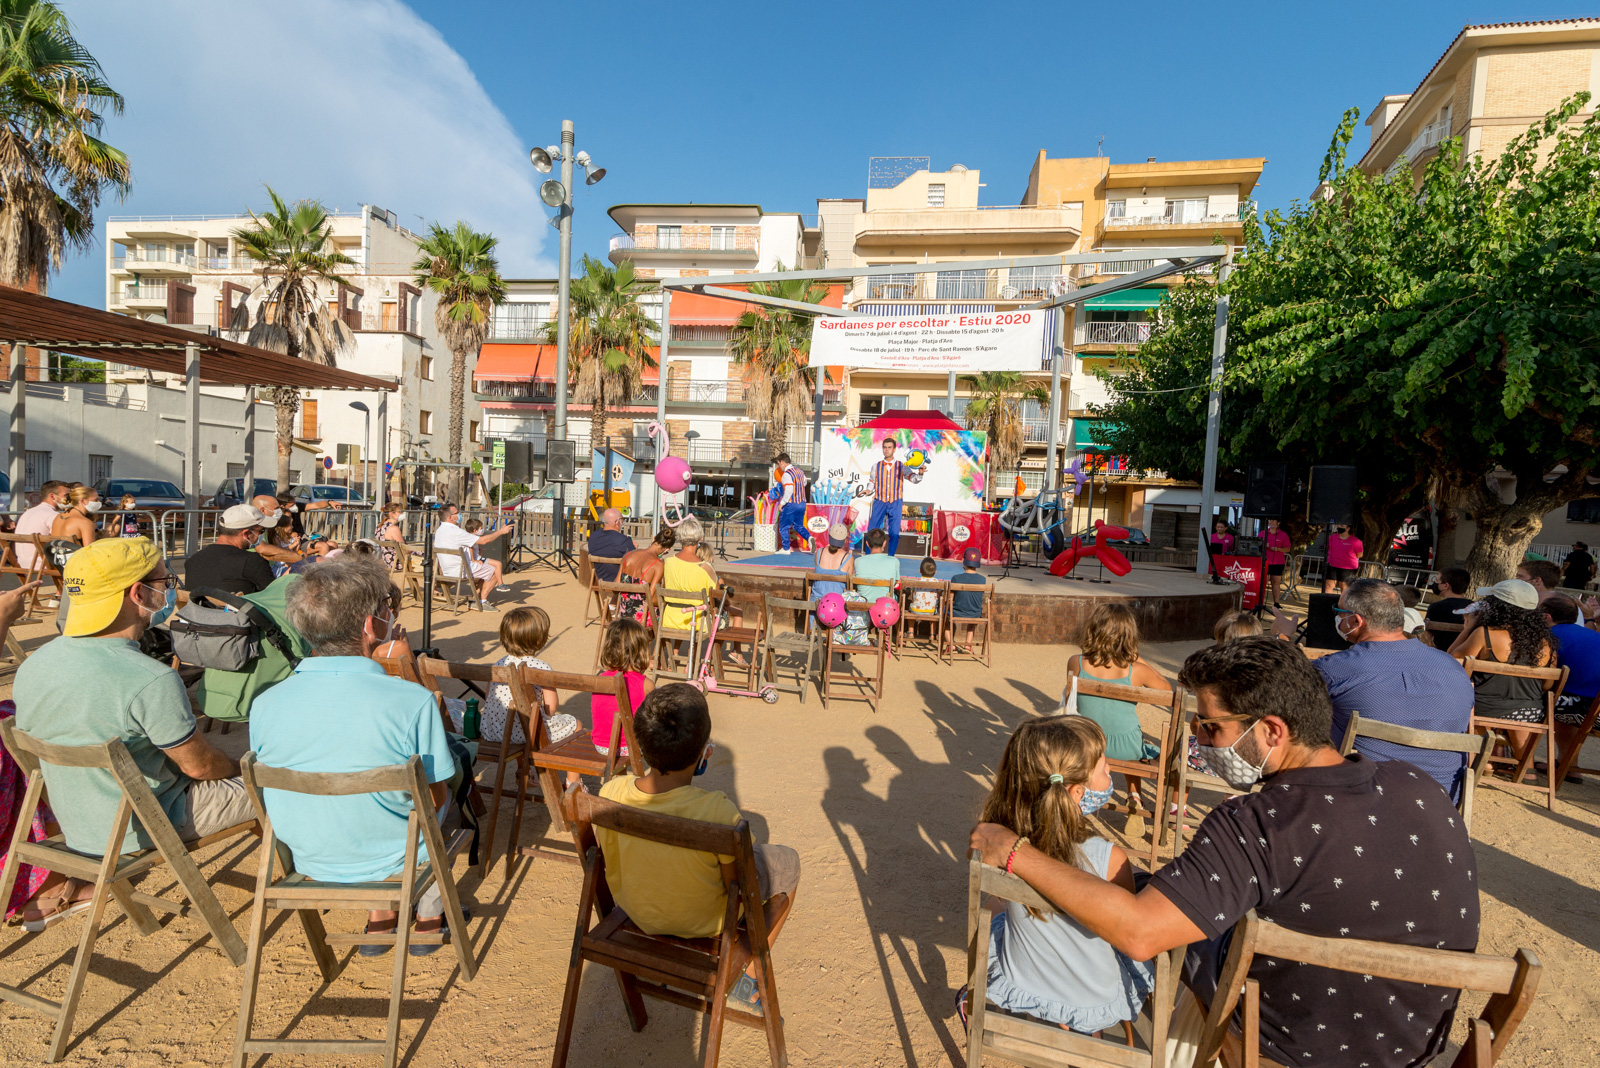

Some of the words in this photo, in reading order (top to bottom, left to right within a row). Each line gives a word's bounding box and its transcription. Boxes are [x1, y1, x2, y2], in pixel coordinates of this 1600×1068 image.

[820, 320, 874, 330] Sardanes
[876, 321, 897, 331] per
[899, 317, 949, 328] escoltar
[959, 316, 993, 326] Estiu
[995, 313, 1031, 325] 2020
[828, 467, 844, 479] Soy
